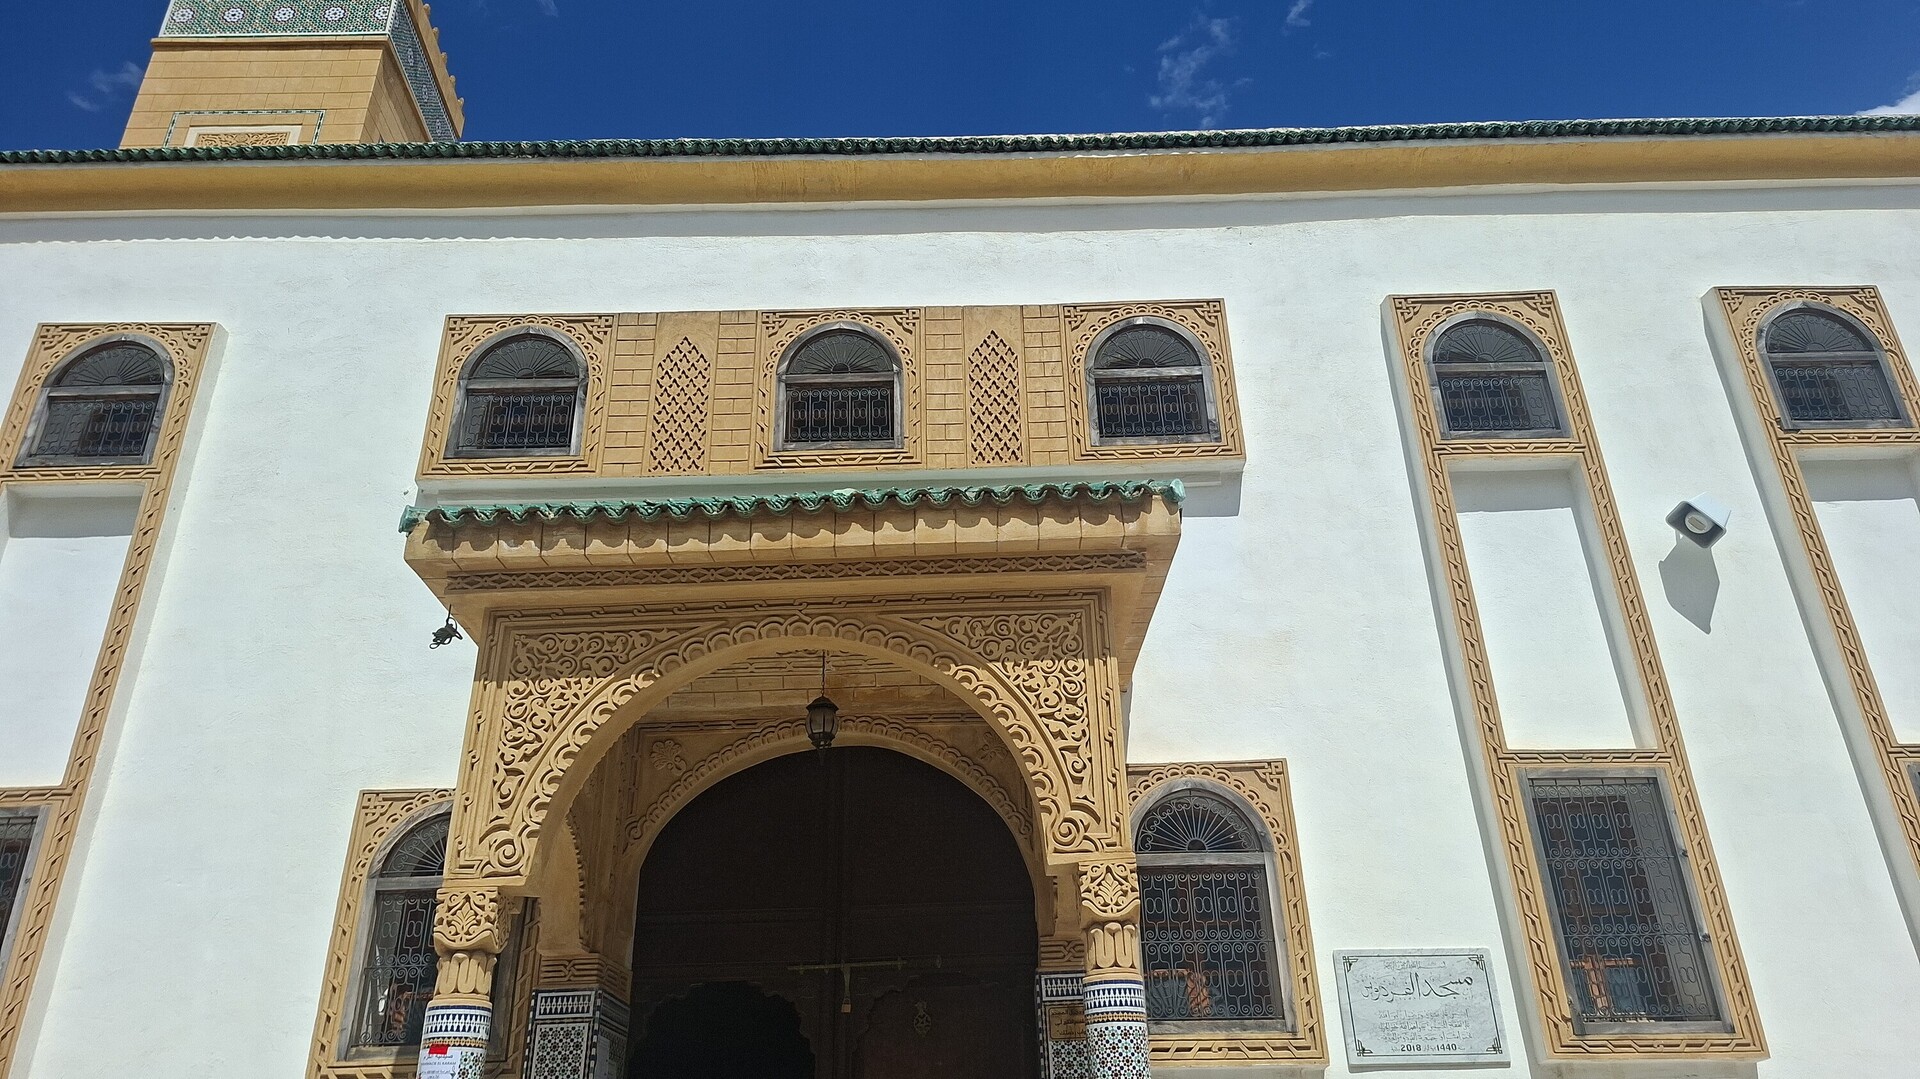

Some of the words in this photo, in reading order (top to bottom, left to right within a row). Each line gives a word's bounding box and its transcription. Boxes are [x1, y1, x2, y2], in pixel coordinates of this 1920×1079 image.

[1361, 972, 1421, 1003] الفردوس
[1422, 975, 1474, 999] مسجد
[1400, 1044, 1422, 1052] 2018
[1437, 1043, 1457, 1051] 1440
